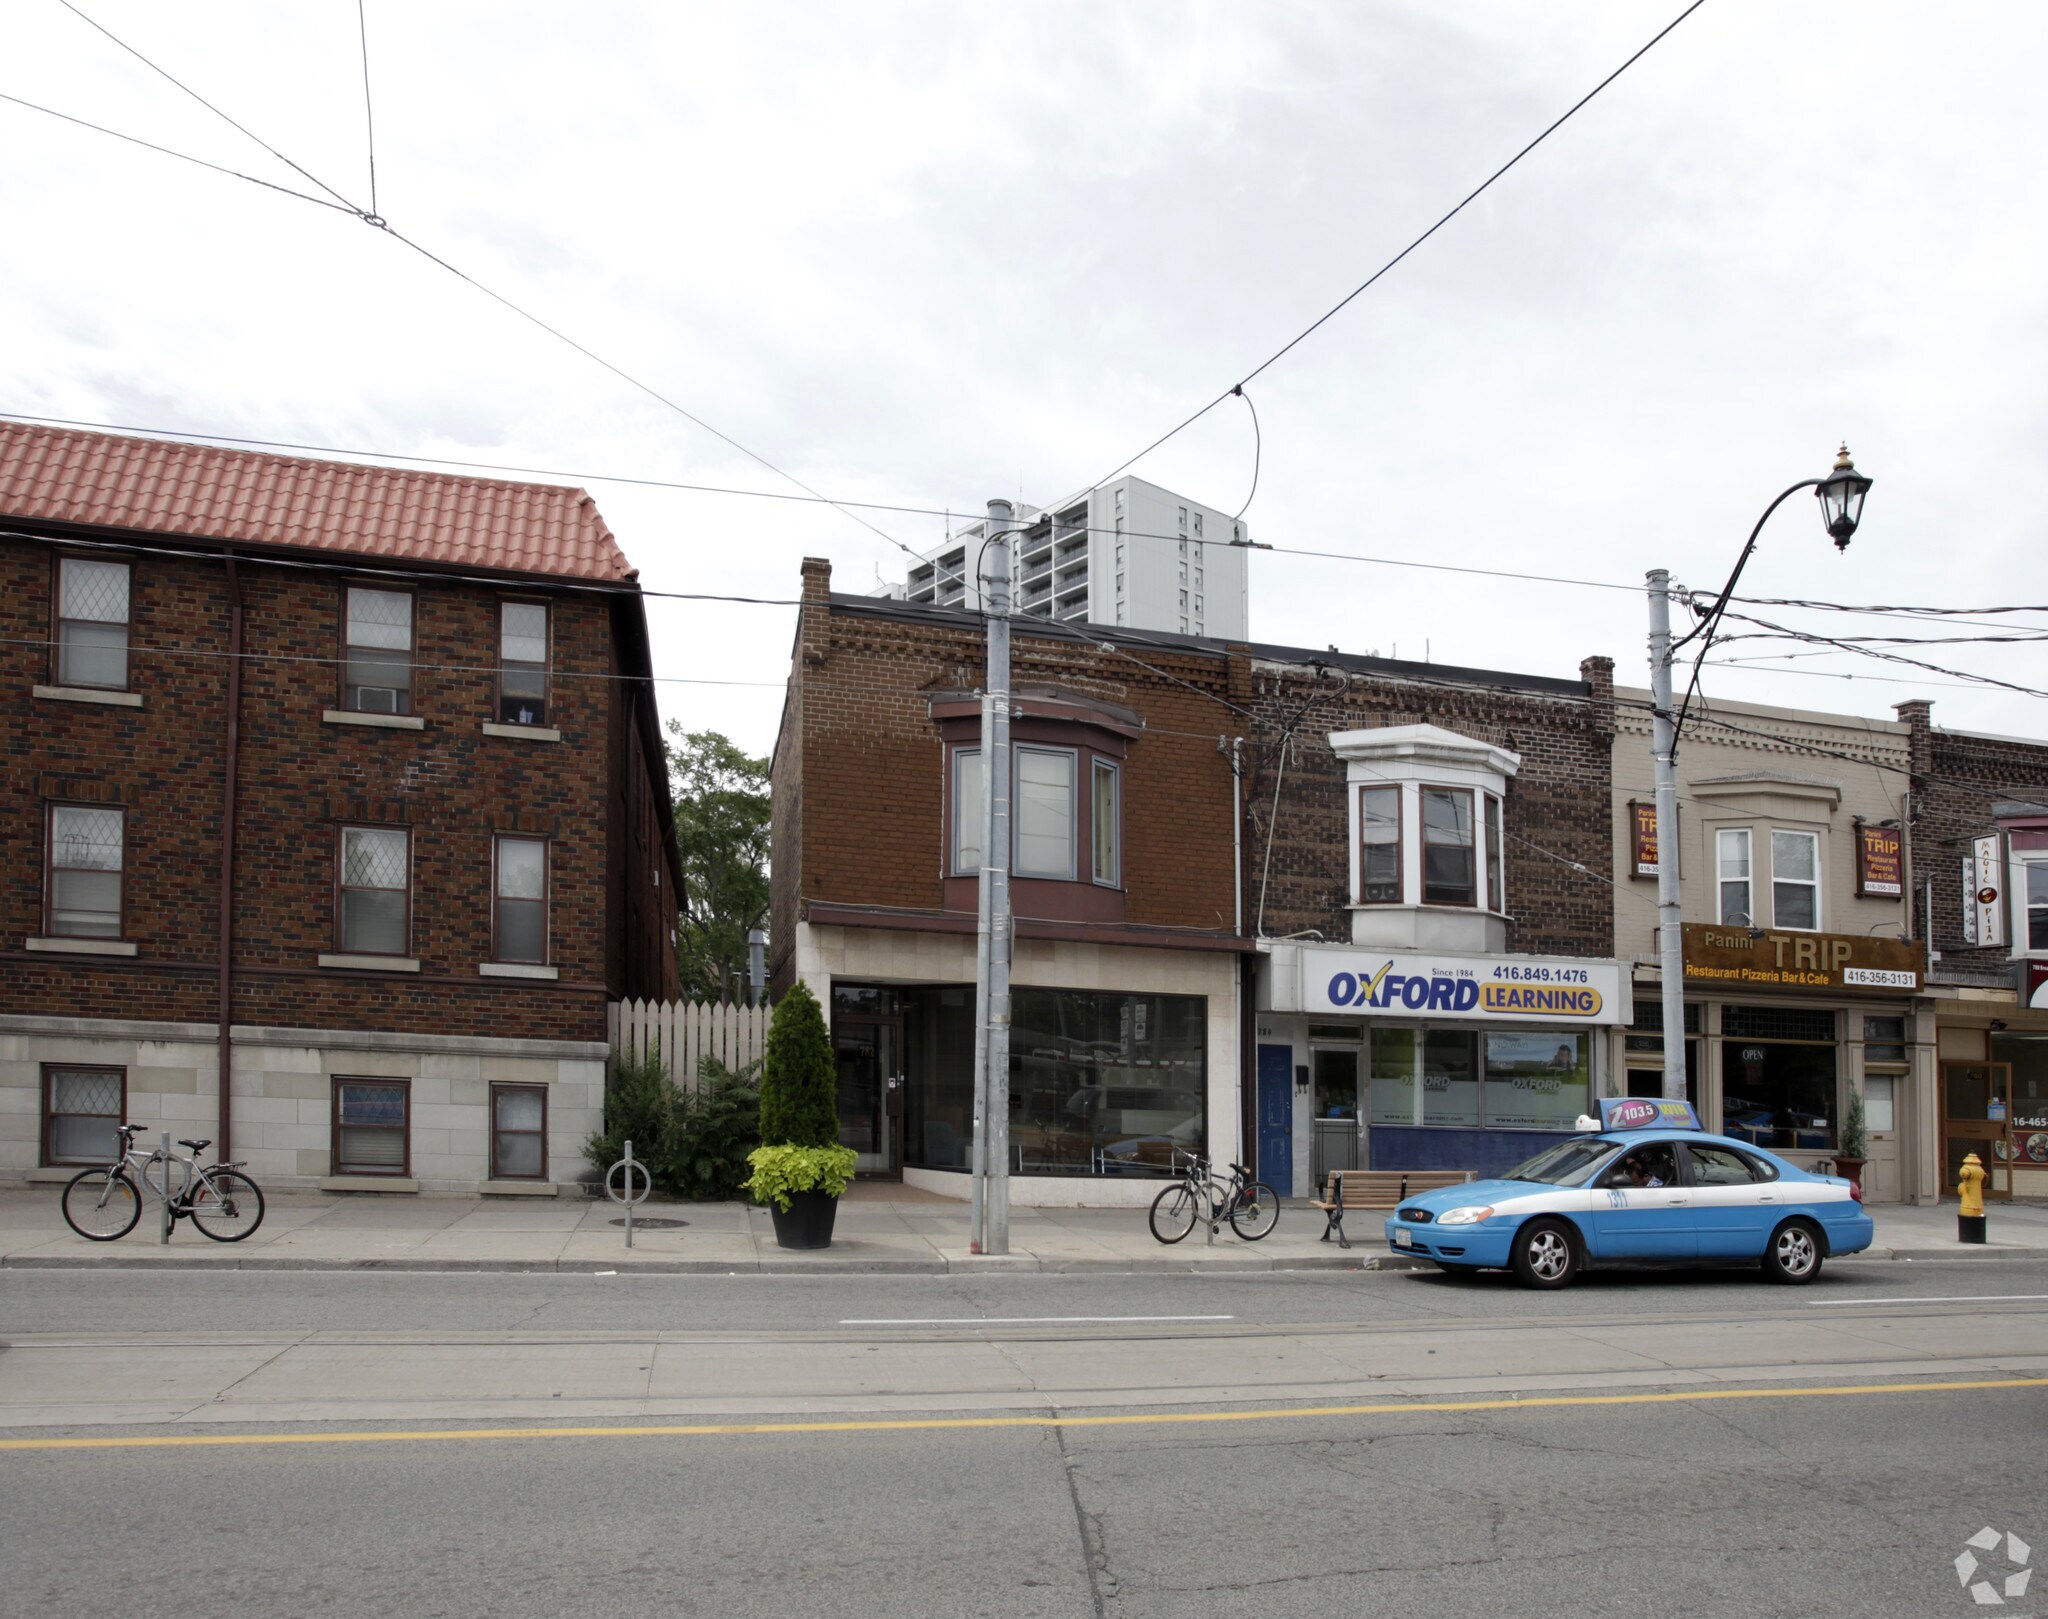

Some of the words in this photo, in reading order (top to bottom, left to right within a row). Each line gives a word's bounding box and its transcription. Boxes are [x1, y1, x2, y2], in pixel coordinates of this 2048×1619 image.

[1638, 817, 1657, 833] TR
[1865, 830, 1881, 838] Panini
[1865, 838, 1899, 854] TRIP
[1867, 855, 1897, 864] Restaurant
[1871, 863, 1893, 871] Pizzeria
[1883, 873, 1896, 881] Cafe
[1866, 883, 1900, 892] 416-356-3131
[1705, 931, 1753, 949] Panini
[1768, 935, 1853, 972] TRIP
[1431, 968, 1453, 977] Since
[1456, 969, 1473, 977] 1984
[1493, 966, 1588, 983] 416.849.1476
[1686, 964, 1739, 979] Restaurant
[1742, 968, 1779, 982] Pizzeria
[1782, 971, 1798, 982] Bar
[1798, 972, 1806, 983] &
[1807, 973, 1829, 985] Cafe
[1848, 970, 1914, 985] 416-356-3131
[1328, 960, 1480, 1011] OXFORD
[1486, 987, 1594, 1011] LEARNING
[1742, 1049, 1764, 1061] OPEN
[1511, 1076, 1562, 1090] OXFORD
[1606, 1191, 1629, 1208] 1311
